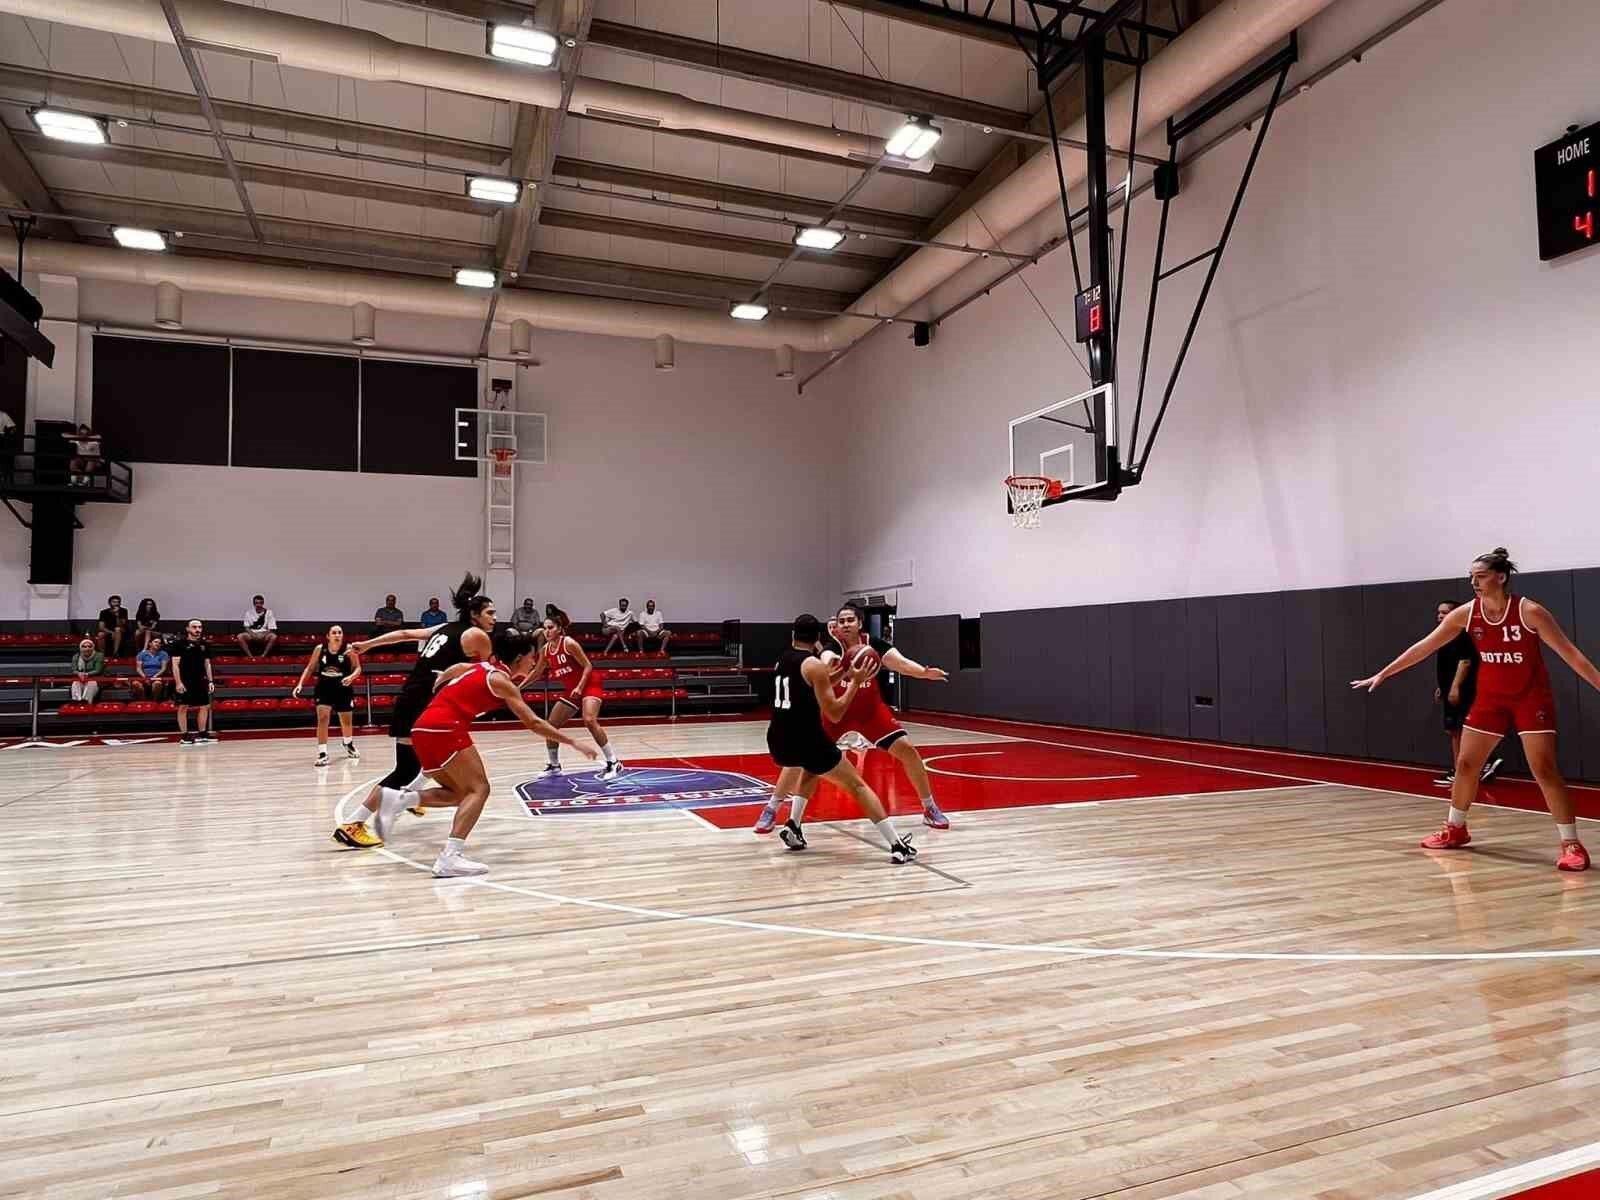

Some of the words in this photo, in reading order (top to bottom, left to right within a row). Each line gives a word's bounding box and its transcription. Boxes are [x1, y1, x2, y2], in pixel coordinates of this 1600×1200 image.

[1557, 137, 1590, 165] HOME
[1574, 211, 1593, 238] 4
[1090, 305, 1100, 332] 8
[1502, 625, 1521, 642] 13
[556, 654, 567, 665] 10
[774, 675, 791, 709] 11
